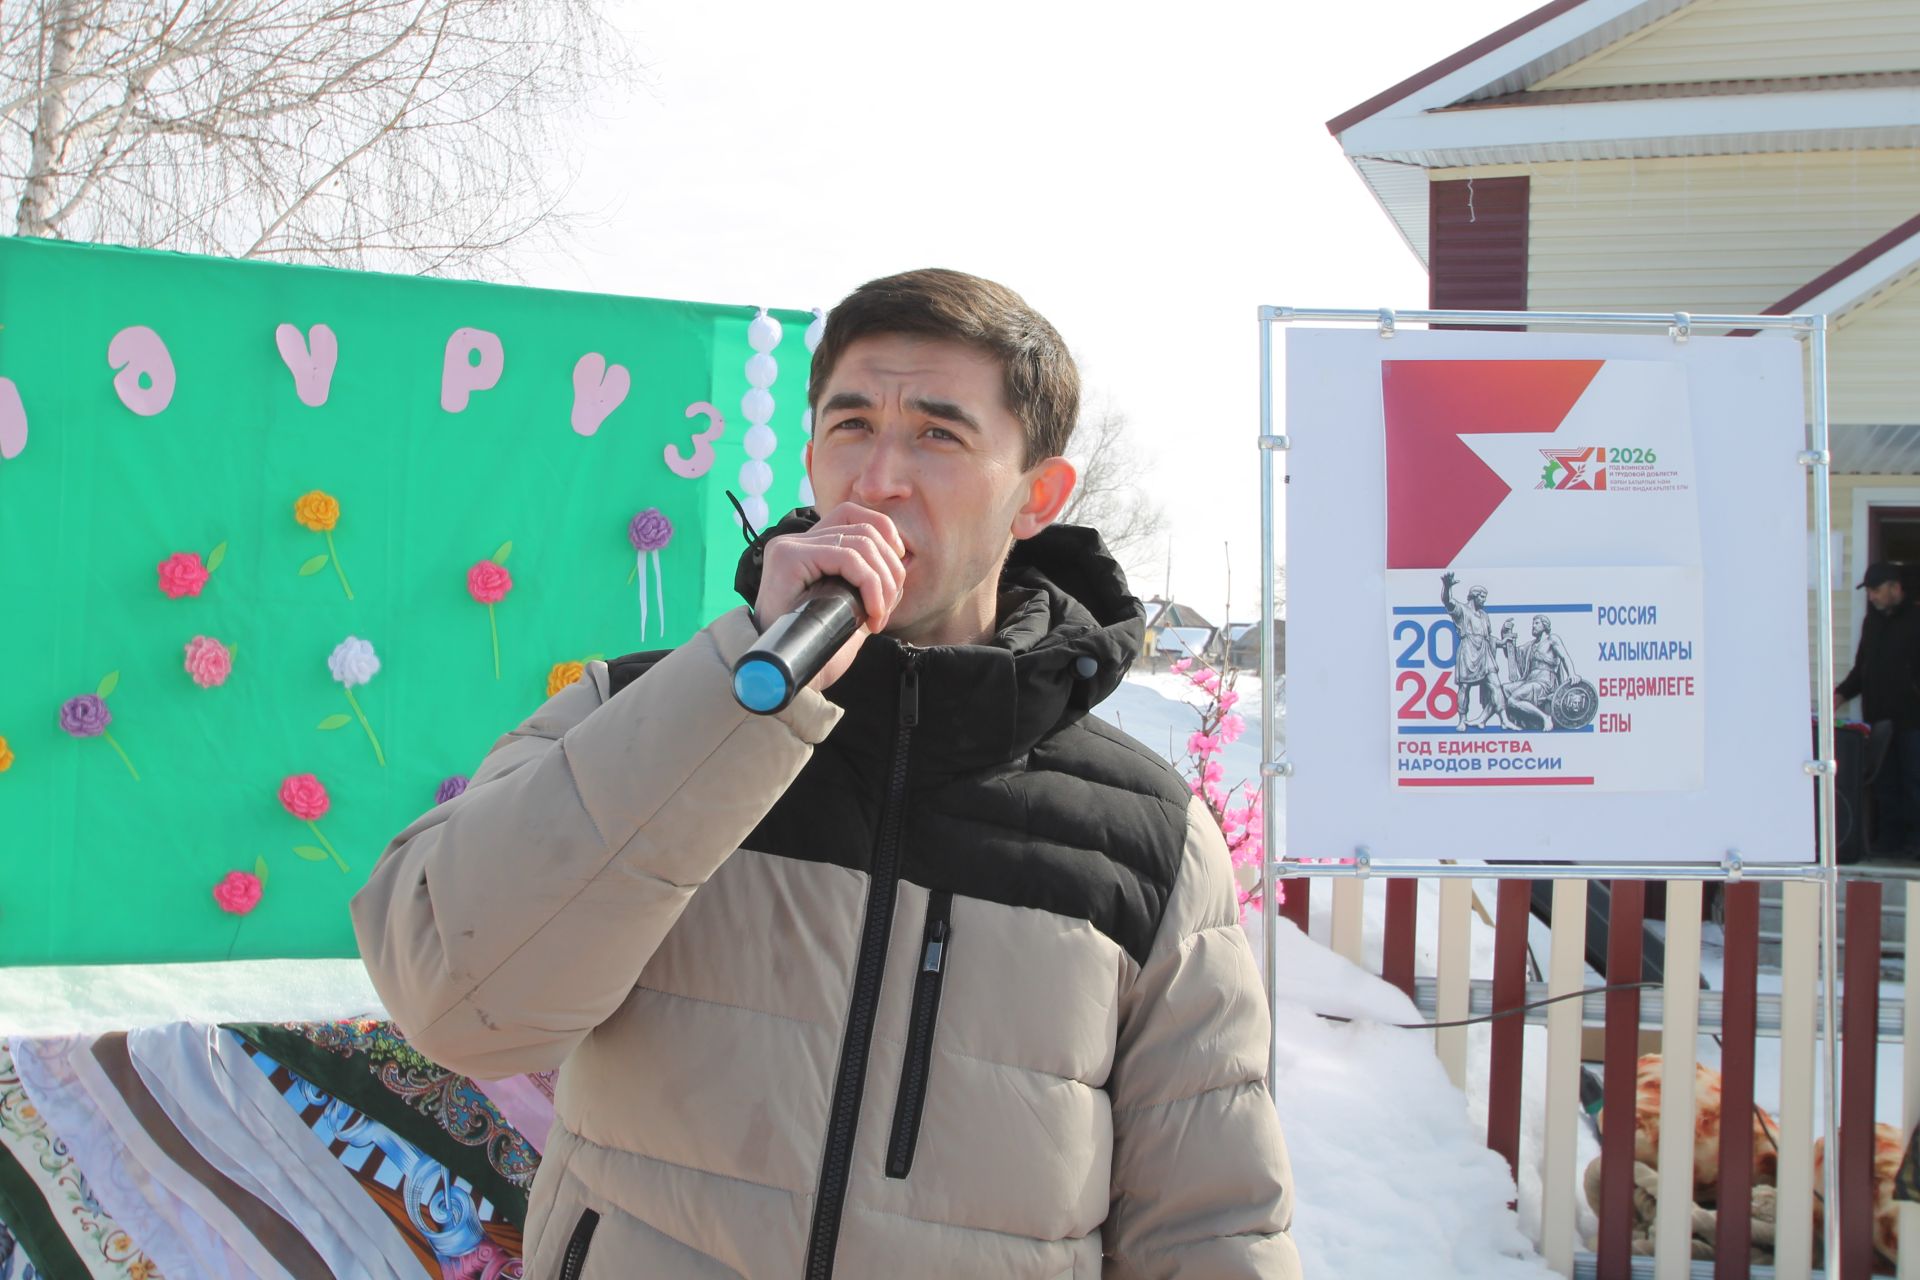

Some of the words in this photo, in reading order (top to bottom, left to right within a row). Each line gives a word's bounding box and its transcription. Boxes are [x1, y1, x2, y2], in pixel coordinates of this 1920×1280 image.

[1609, 447, 1657, 464] 2026
[1597, 605, 1657, 626] РОССИЯ
[1393, 619, 1460, 669] 20
[1598, 641, 1692, 661] ХАЛЫКЛАРЫ
[1395, 670, 1459, 720] 26
[1599, 677, 1695, 700] БЕРДӘМЛЕГЕ
[1599, 713, 1632, 733] ЕЛЫ
[1398, 741, 1432, 756] ГОД
[1438, 740, 1533, 756] ЕДИНСТВА
[1398, 758, 1482, 773] НАРОДОВ
[1487, 757, 1562, 771] РОССИИ
